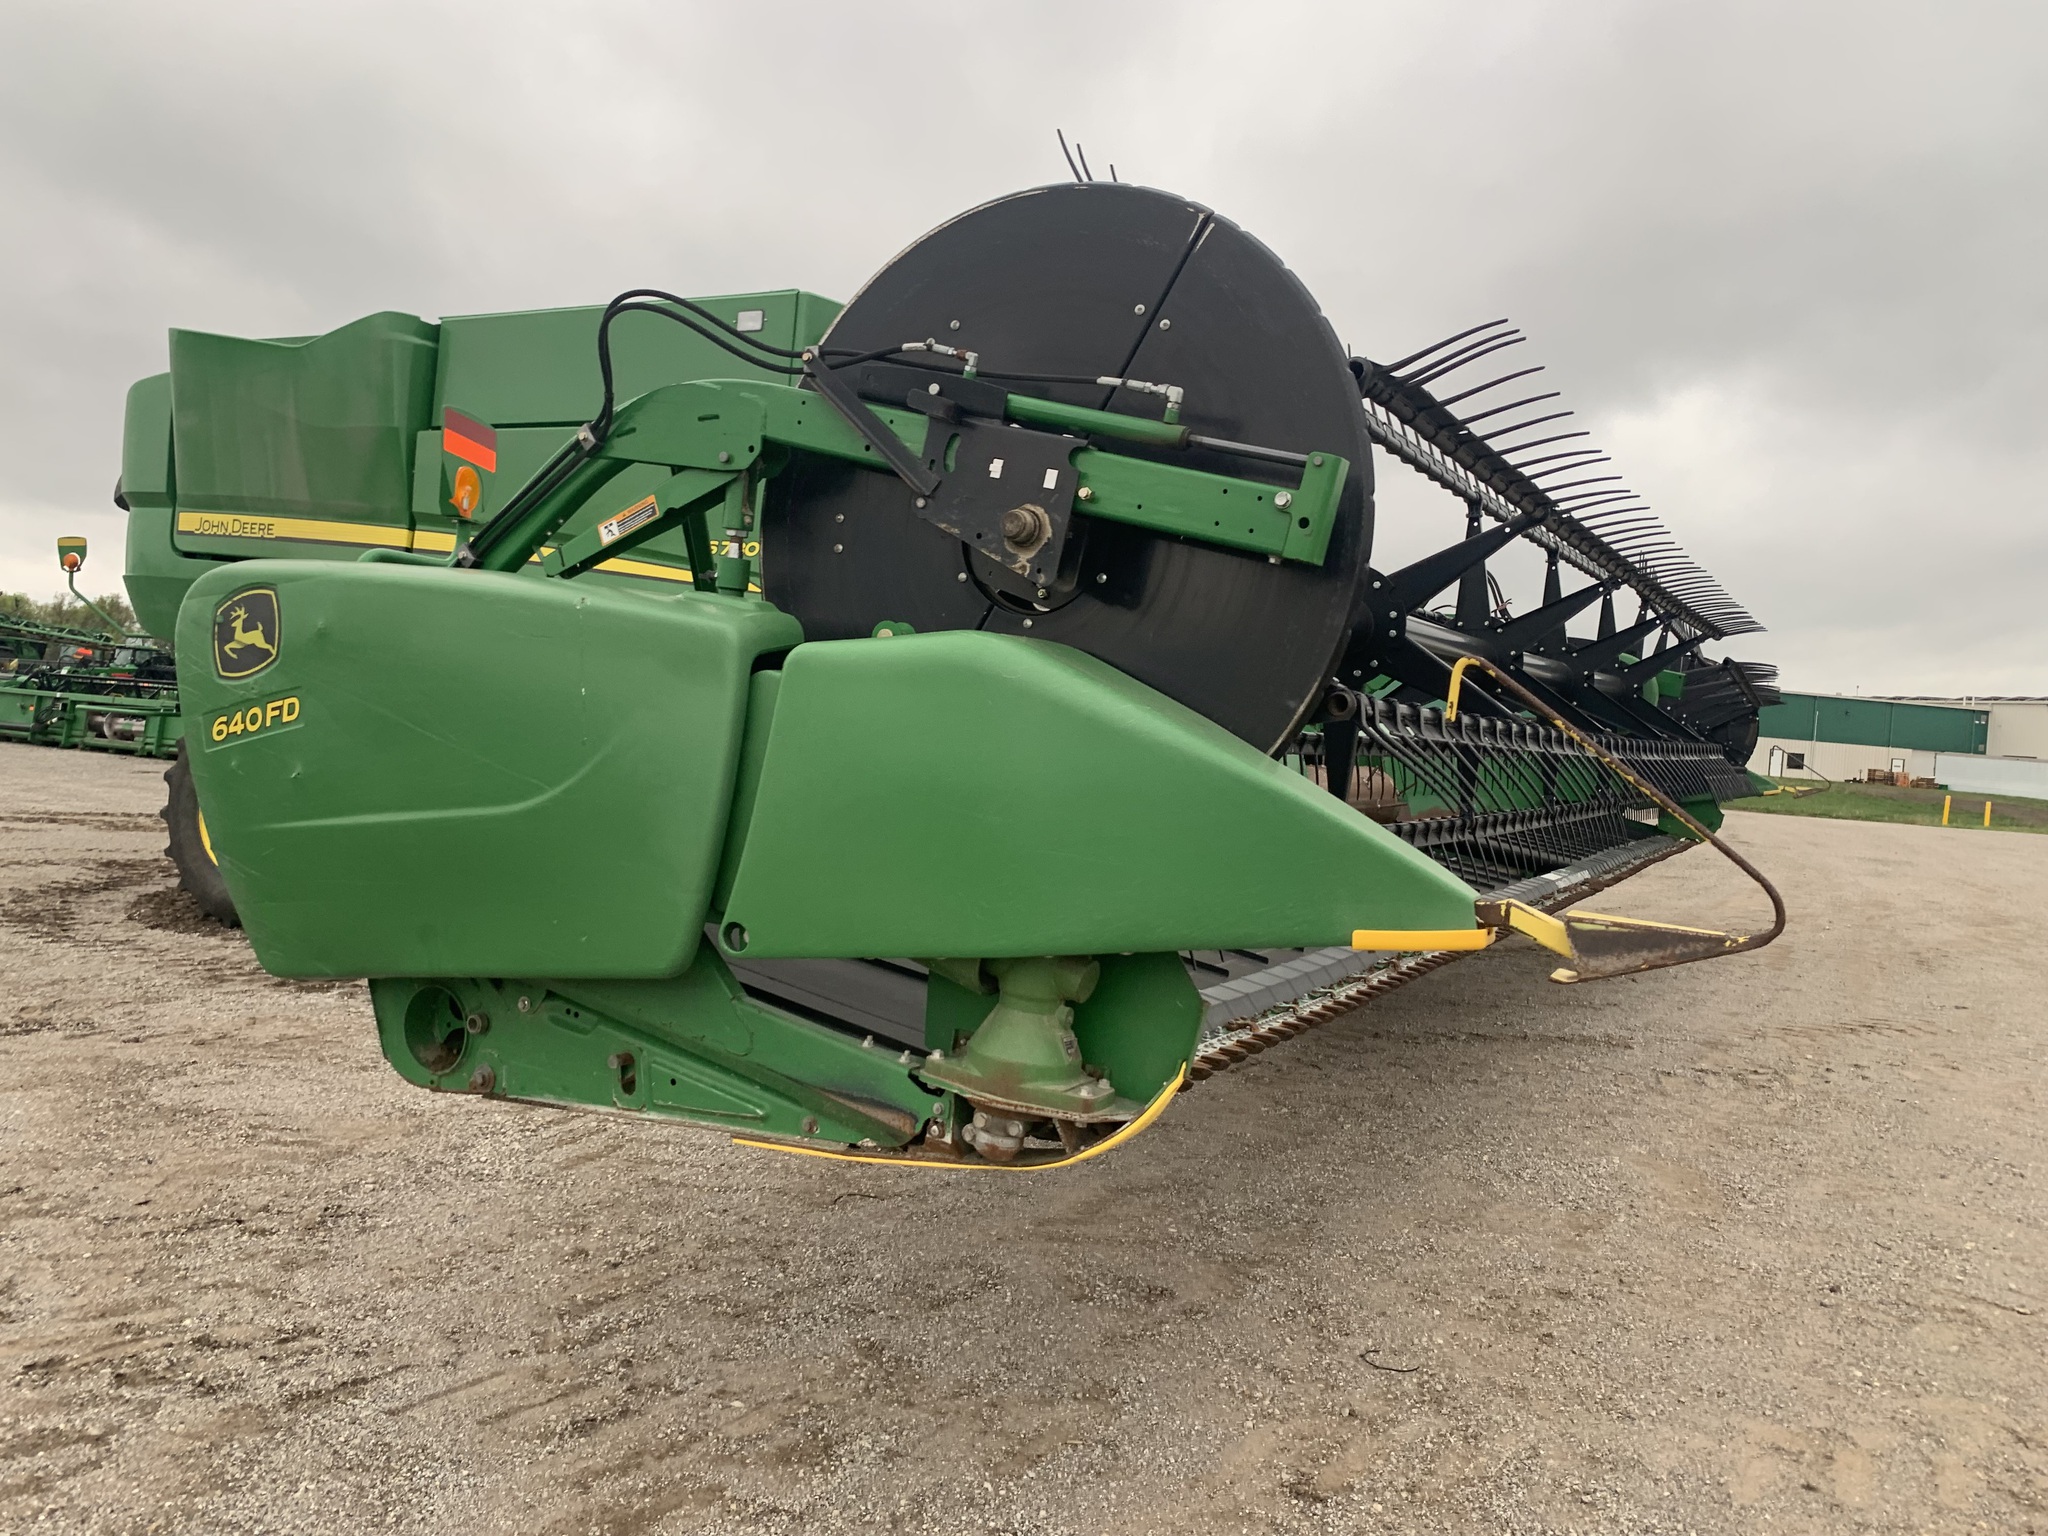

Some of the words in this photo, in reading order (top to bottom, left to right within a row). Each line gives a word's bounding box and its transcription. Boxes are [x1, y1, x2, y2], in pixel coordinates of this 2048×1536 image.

[195, 517, 229, 533] JOHN
[232, 518, 275, 536] DEERE
[709, 540, 760, 557] S70
[212, 696, 300, 742] 640FD
